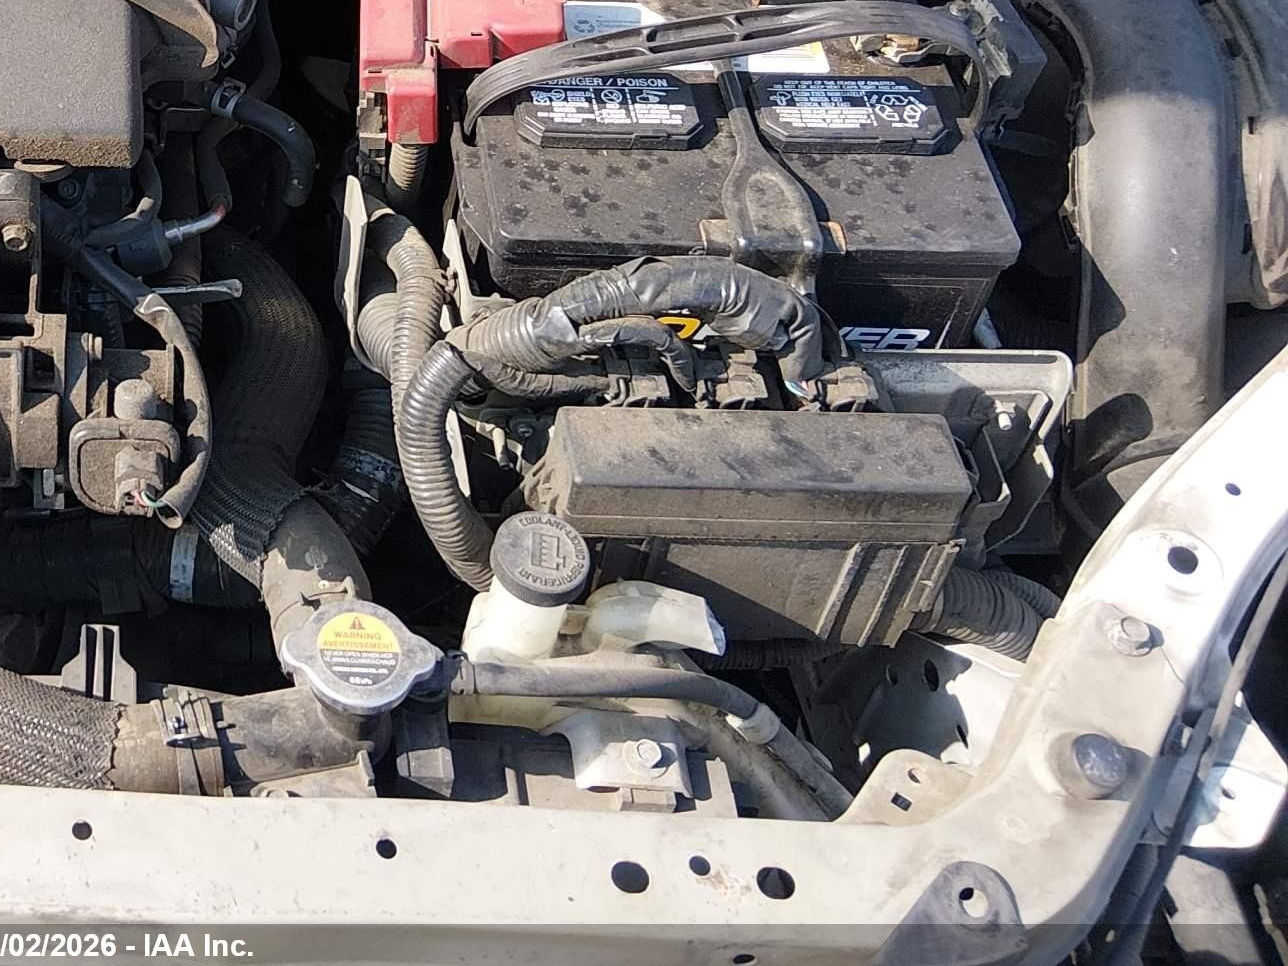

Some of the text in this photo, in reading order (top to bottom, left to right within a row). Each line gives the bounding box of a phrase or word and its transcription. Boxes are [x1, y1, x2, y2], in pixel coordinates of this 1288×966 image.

[618, 78, 668, 87] POISON
[334, 631, 382, 640] WARNING
[323, 640, 394, 650] AVERTISSEMENT
